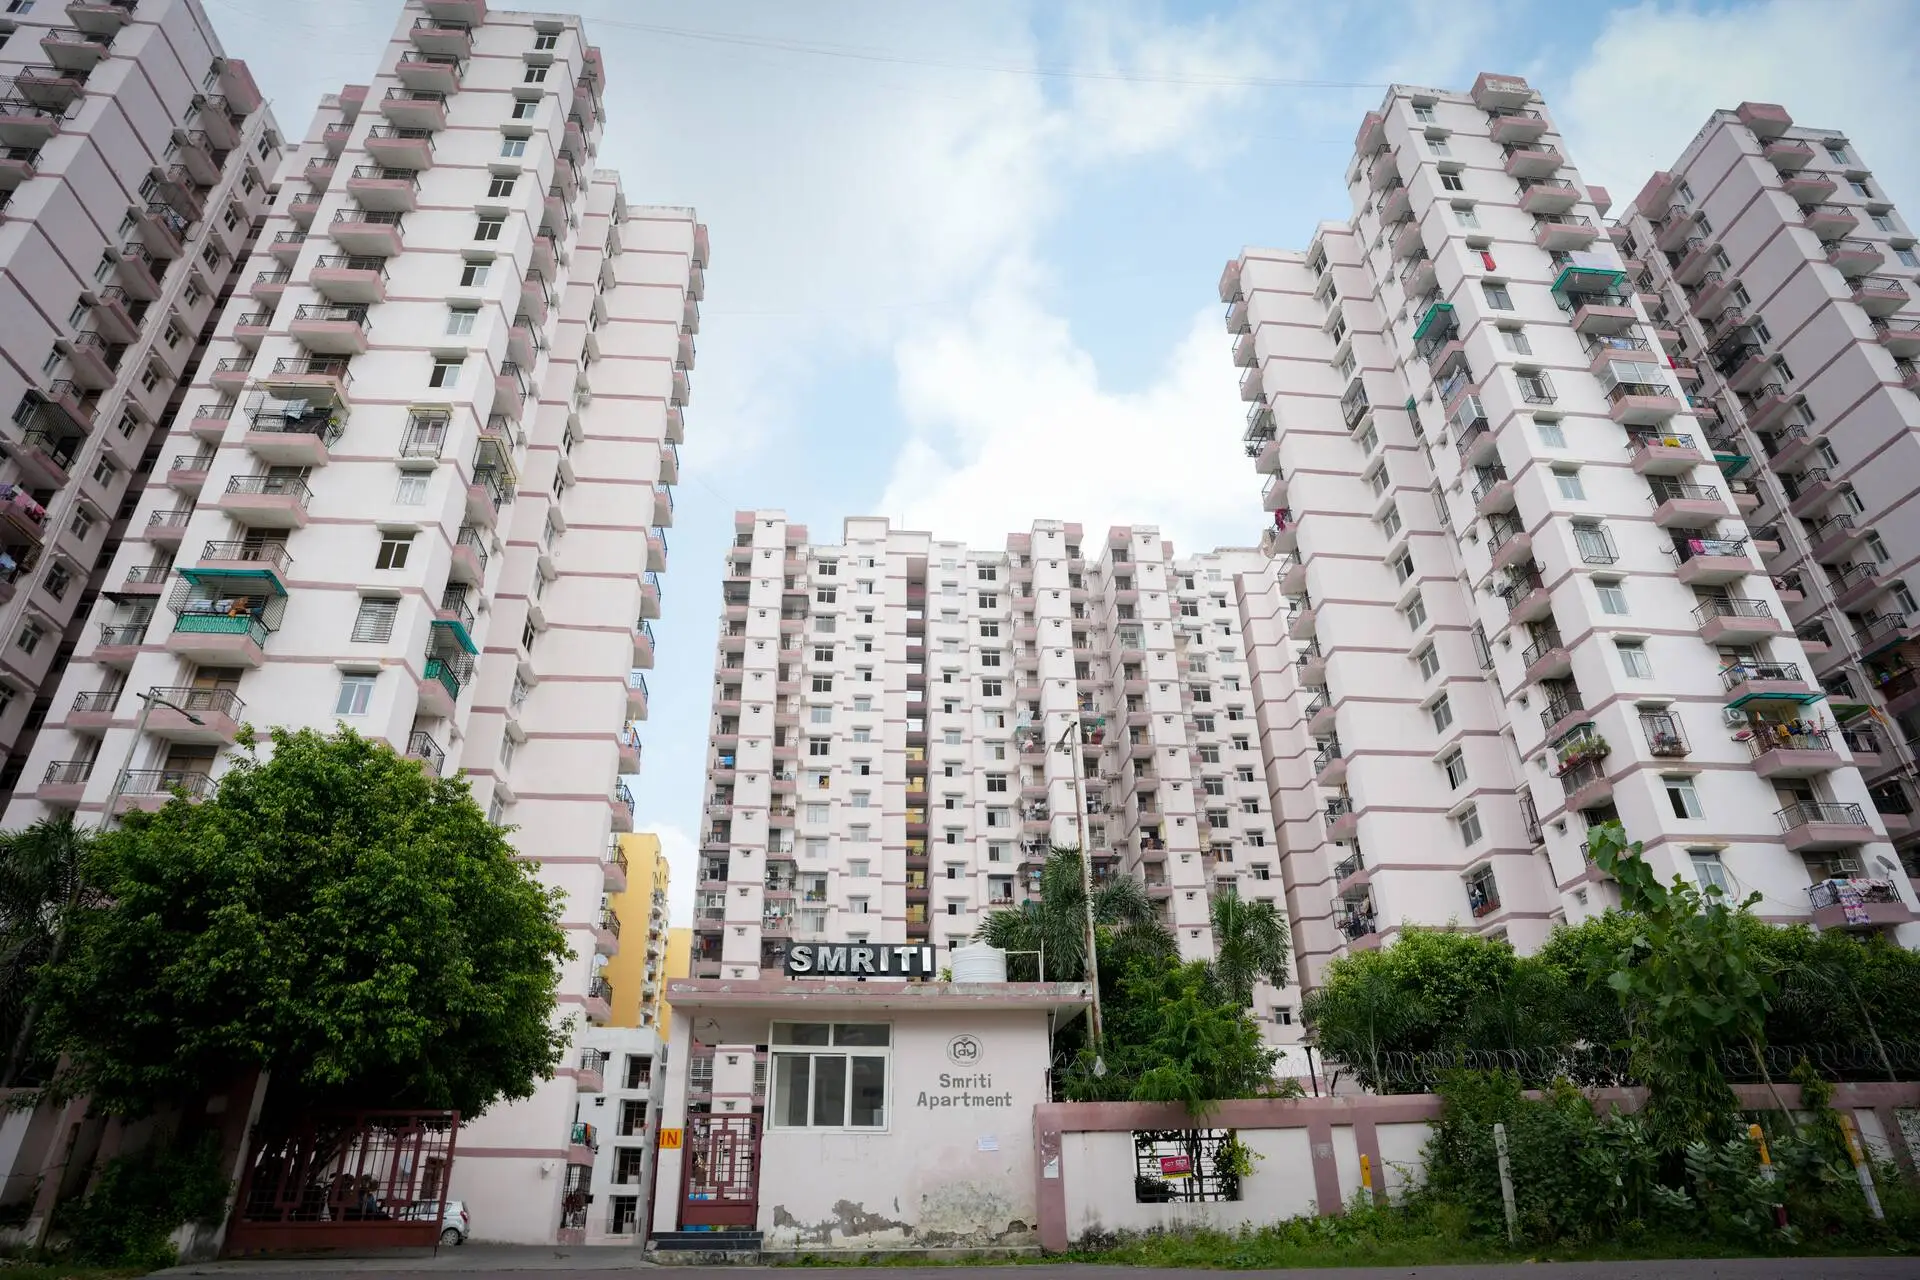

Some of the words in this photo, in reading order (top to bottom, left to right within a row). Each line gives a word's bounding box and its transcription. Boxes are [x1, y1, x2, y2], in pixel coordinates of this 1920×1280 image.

[789, 945, 932, 973] SMRITI
[939, 1073, 992, 1089] Smriti
[916, 1091, 1013, 1111] Apartment
[660, 1131, 679, 1146] IN
